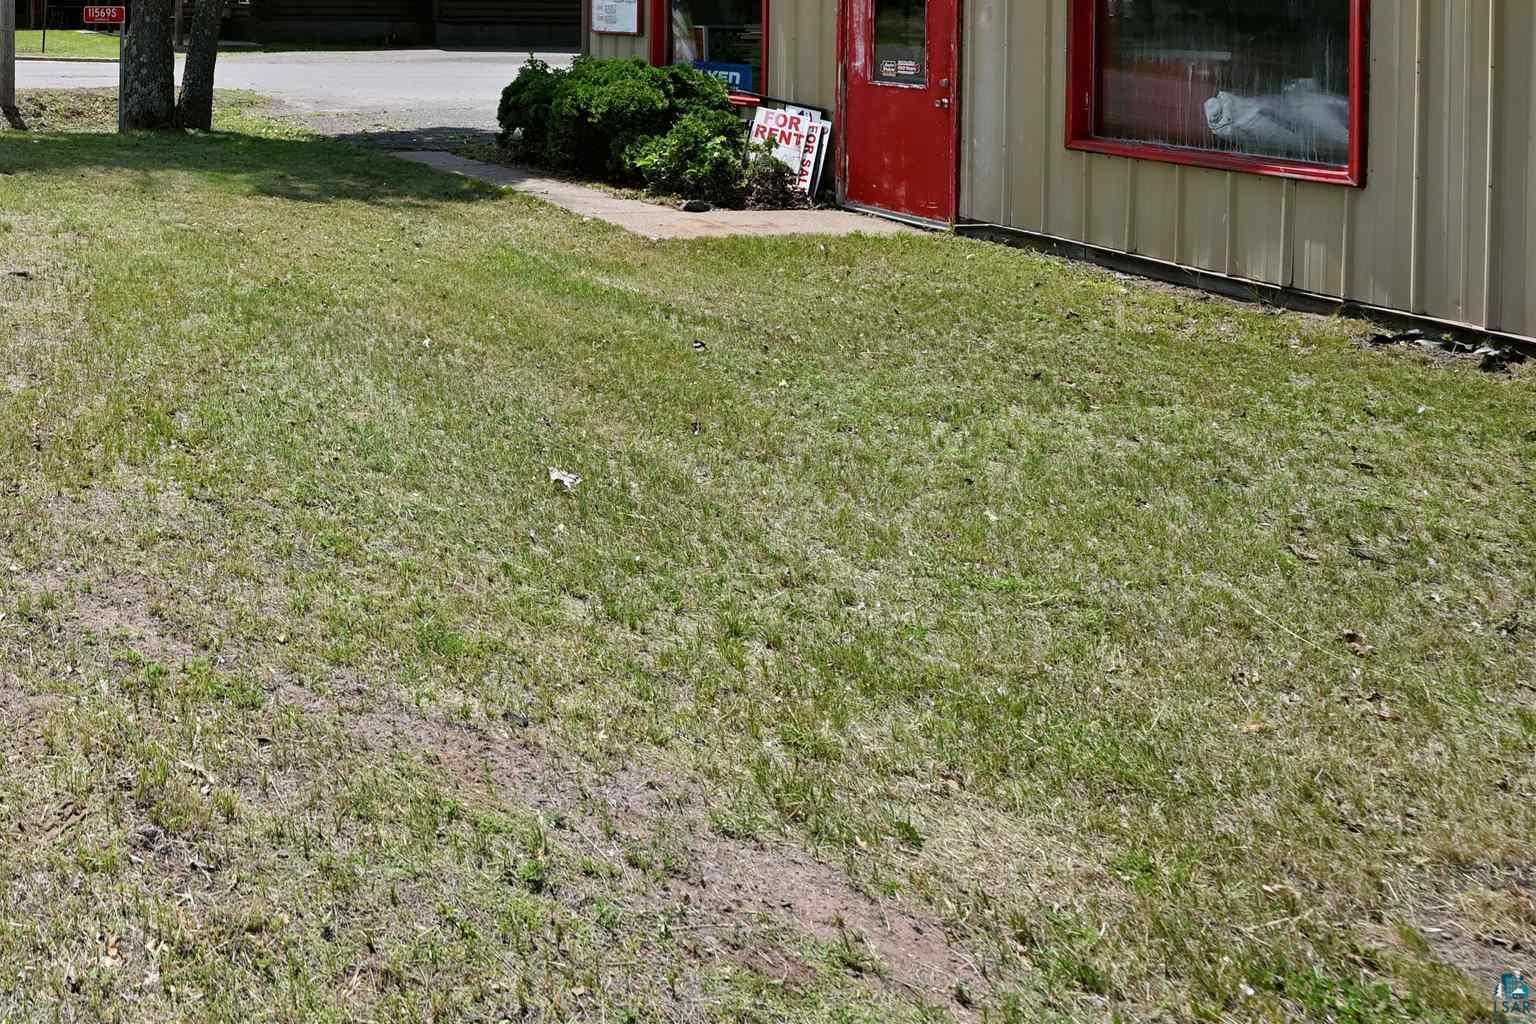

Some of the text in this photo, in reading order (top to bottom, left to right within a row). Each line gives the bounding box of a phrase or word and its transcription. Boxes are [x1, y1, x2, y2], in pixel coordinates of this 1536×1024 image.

[764, 110, 801, 132] FOR
[754, 123, 805, 146] RENT
[803, 125, 818, 154] FOR
[798, 159, 811, 188] SAL
